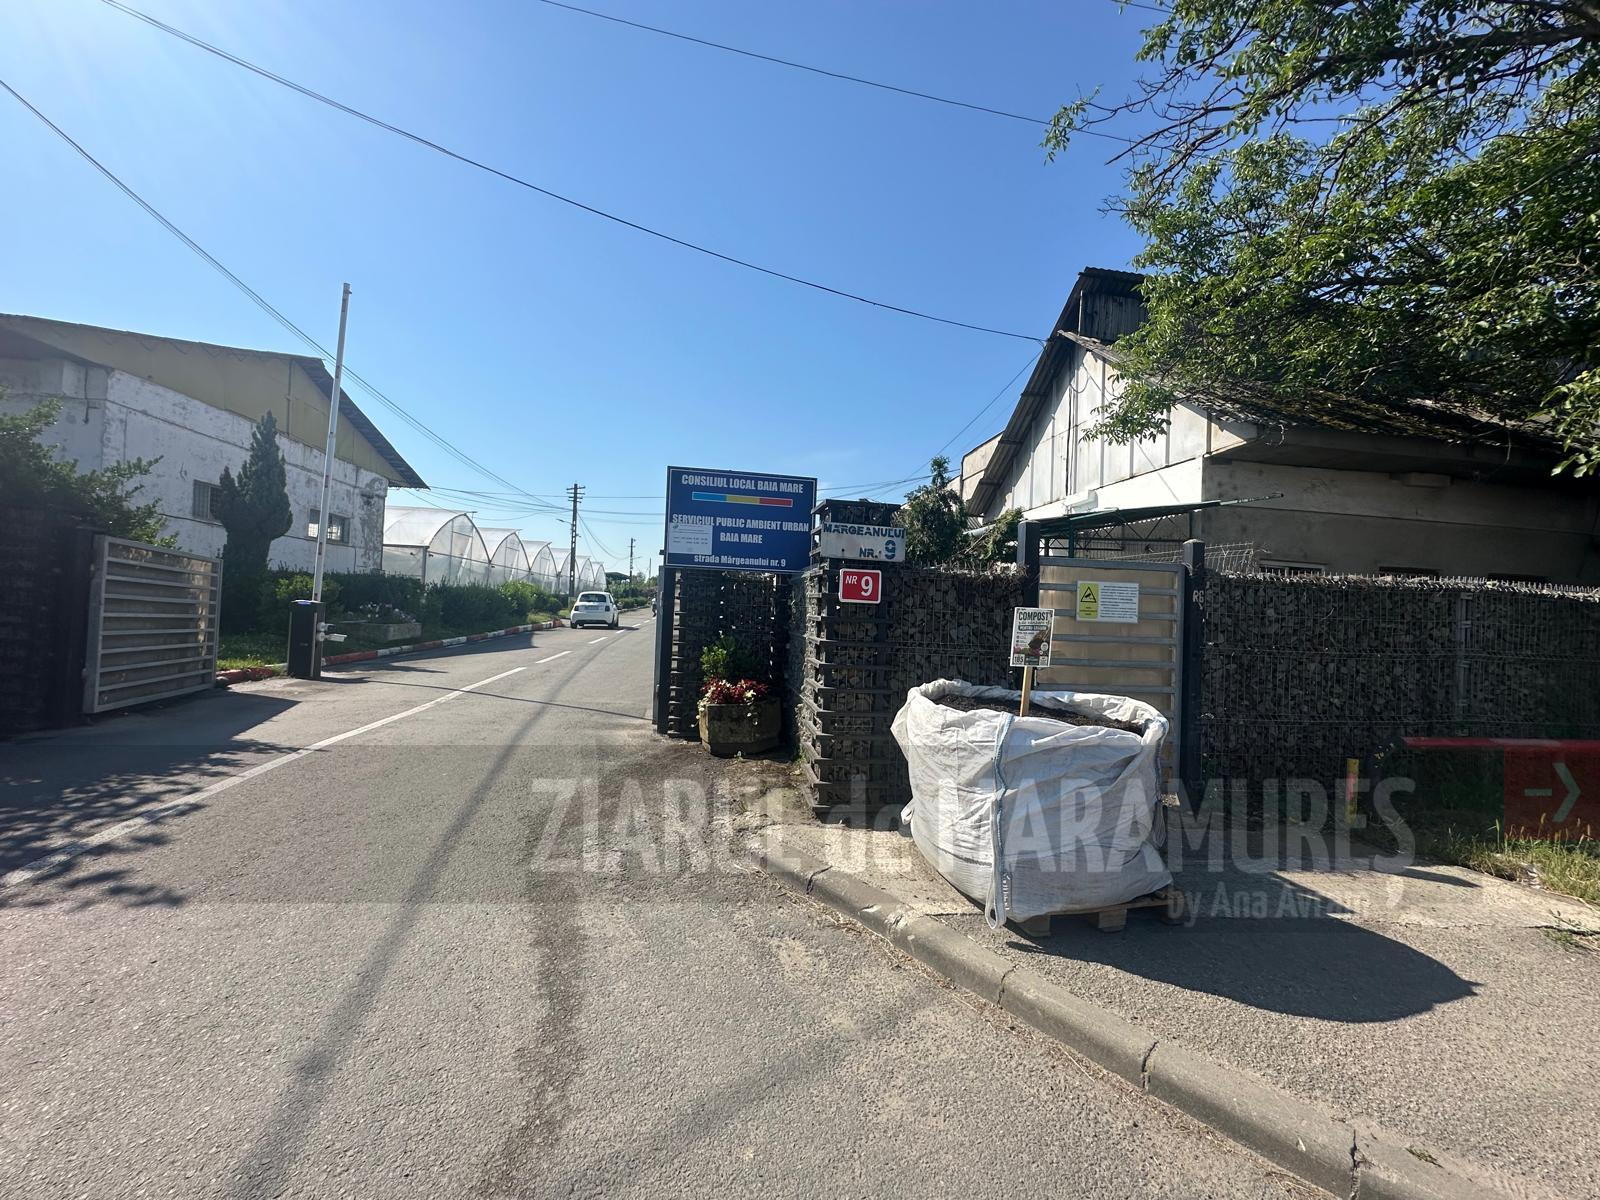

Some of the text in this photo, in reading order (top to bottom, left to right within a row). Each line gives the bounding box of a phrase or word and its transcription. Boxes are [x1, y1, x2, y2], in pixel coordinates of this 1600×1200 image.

[681, 474, 804, 493] CONSILIUL LOCAL BAIA MARE
[672, 513, 809, 532] SERVICIUL PUBLIC AMBIENT URBAN
[720, 532, 739, 543] BAIA
[740, 533, 763, 544] MARE
[884, 539, 897, 560] 9
[693, 554, 719, 563] strada
[770, 559, 780, 567] nr.
[779, 558, 786, 567] 9
[845, 575, 873, 597] NR 9
[1018, 611, 1049, 621] COMPOST
